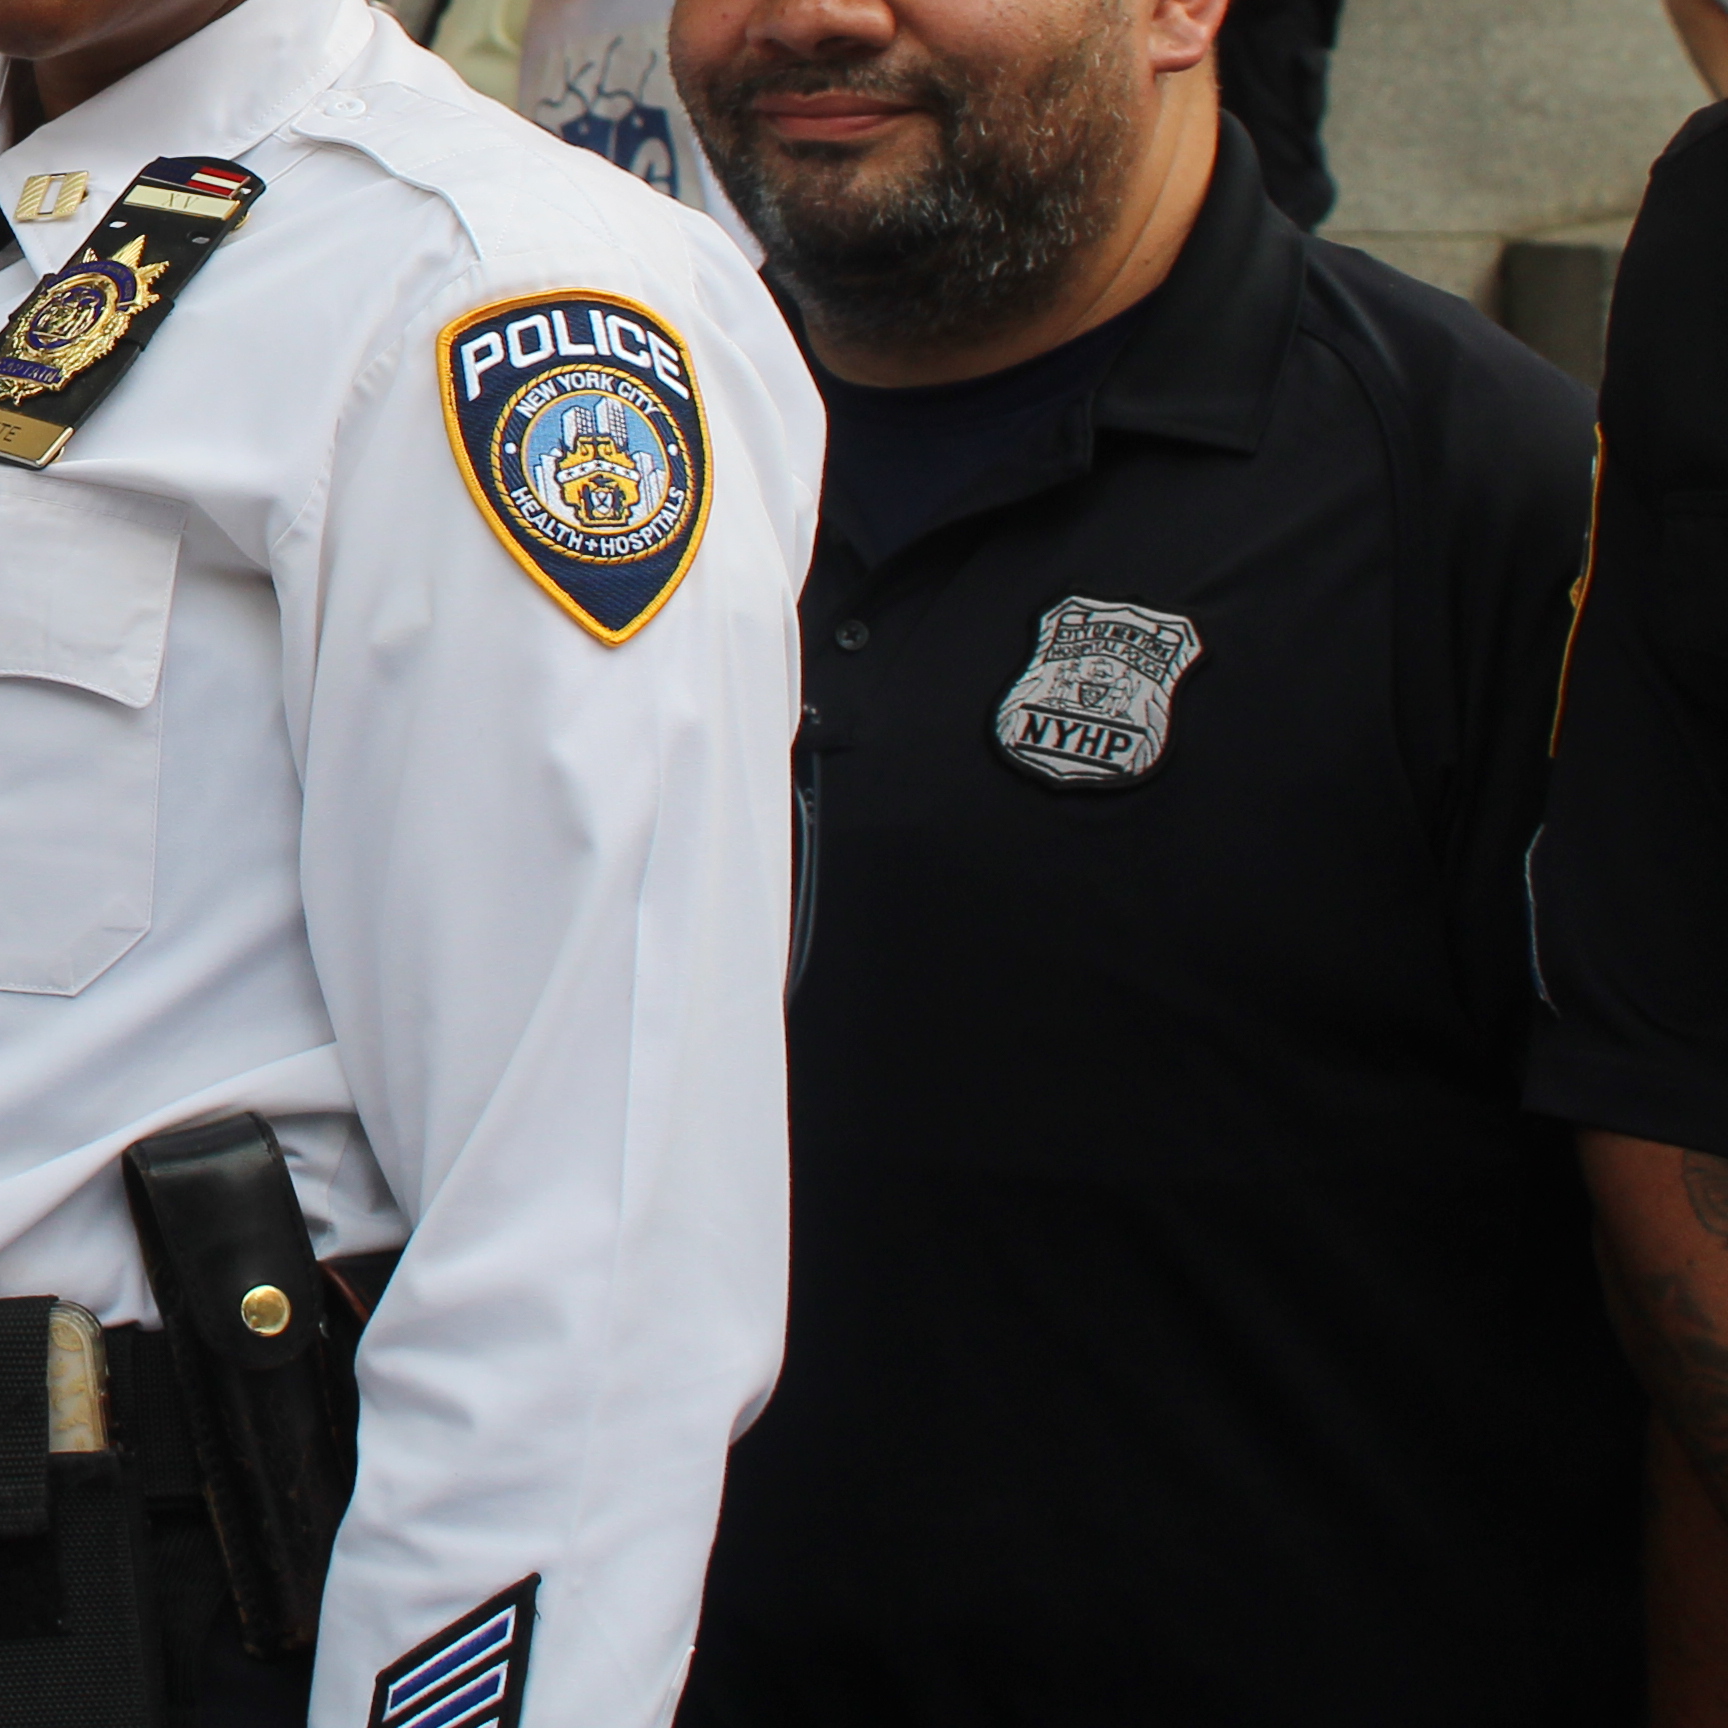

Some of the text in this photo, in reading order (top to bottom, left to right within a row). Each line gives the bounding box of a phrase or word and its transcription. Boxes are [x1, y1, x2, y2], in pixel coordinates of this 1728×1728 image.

[460, 309, 691, 401] POLICE
[515, 370, 661, 419] NEW YORK CITY
[510, 484, 585, 551] HEALTH
[599, 484, 686, 556] HOSPITALS
[1059, 624, 1088, 640] CITY
[1092, 623, 1108, 638] OF
[1049, 639, 1166, 679] HOSPITAL POLICE
[1019, 712, 1133, 761] NYHP
